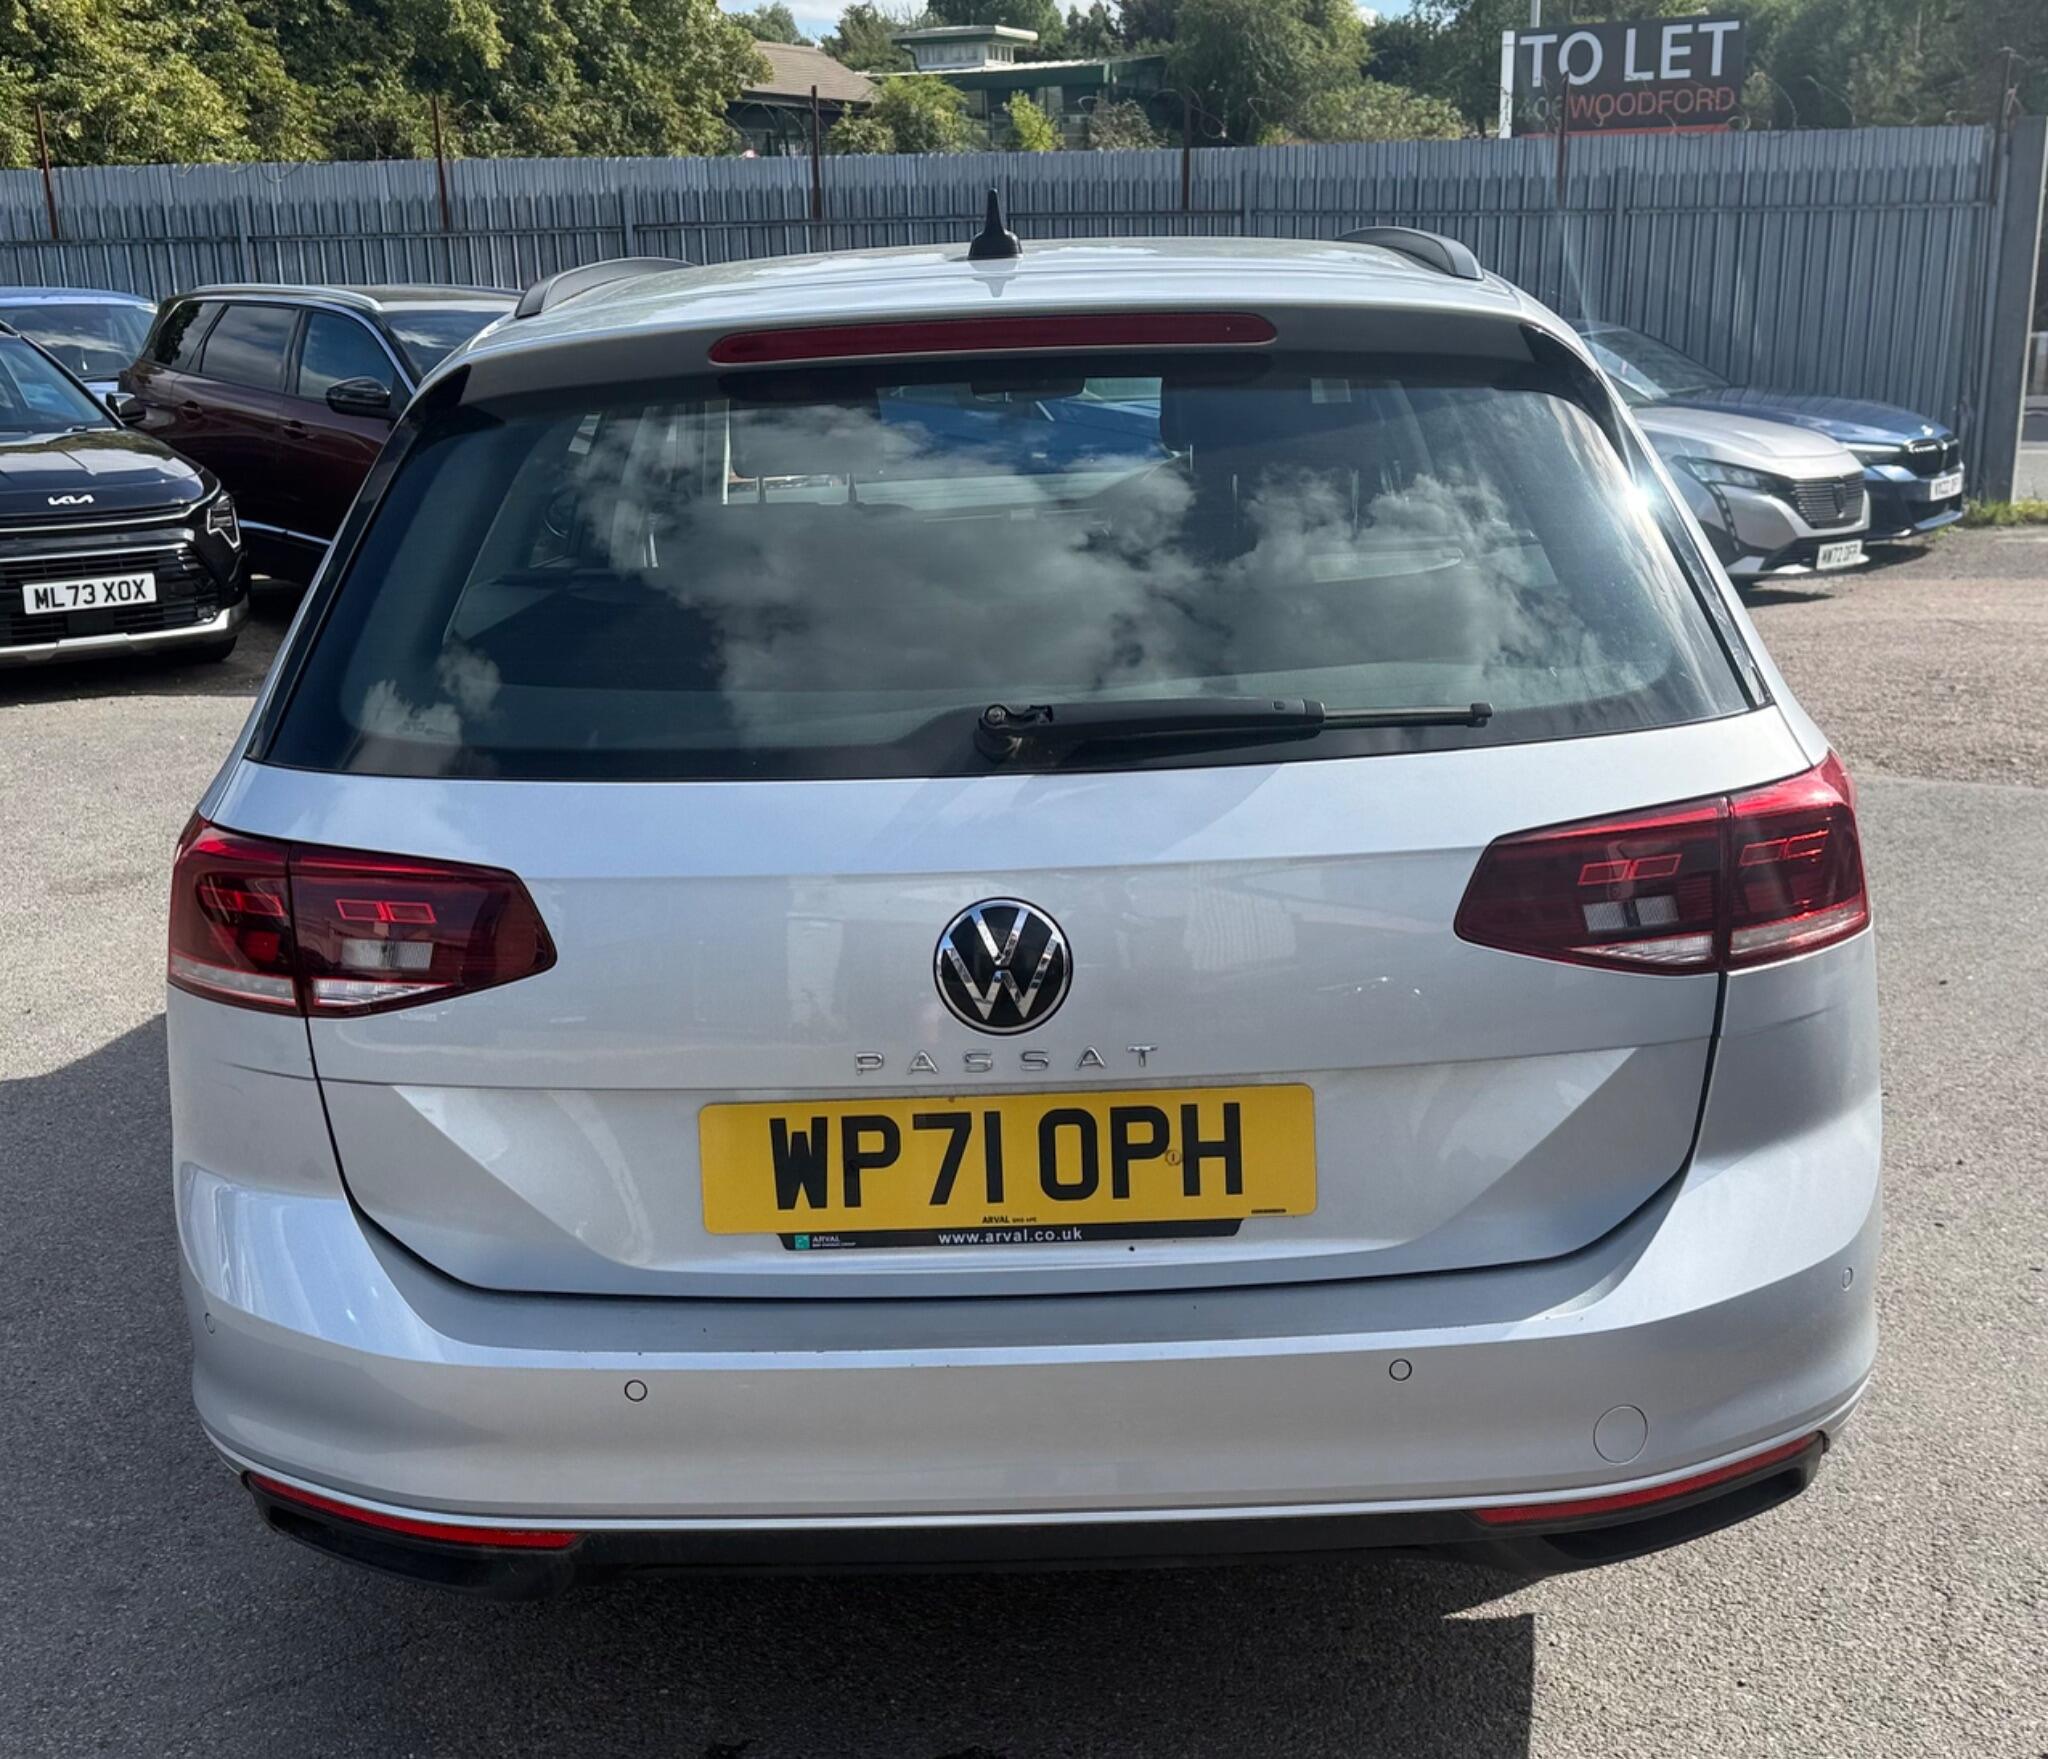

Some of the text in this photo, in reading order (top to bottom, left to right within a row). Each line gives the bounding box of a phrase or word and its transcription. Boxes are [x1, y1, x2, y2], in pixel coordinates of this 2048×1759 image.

[1520, 20, 1740, 87] TO LET
[1568, 86, 1735, 119] WOODFORD
[35, 579, 146, 610] ML73 XOX
[855, 1044, 1158, 1075] PASSAT
[769, 1103, 1243, 1210] WP71 OPH
[936, 1226, 1083, 1245] www.arval.co.uk
[982, 1216, 1010, 1224] ARVAL
